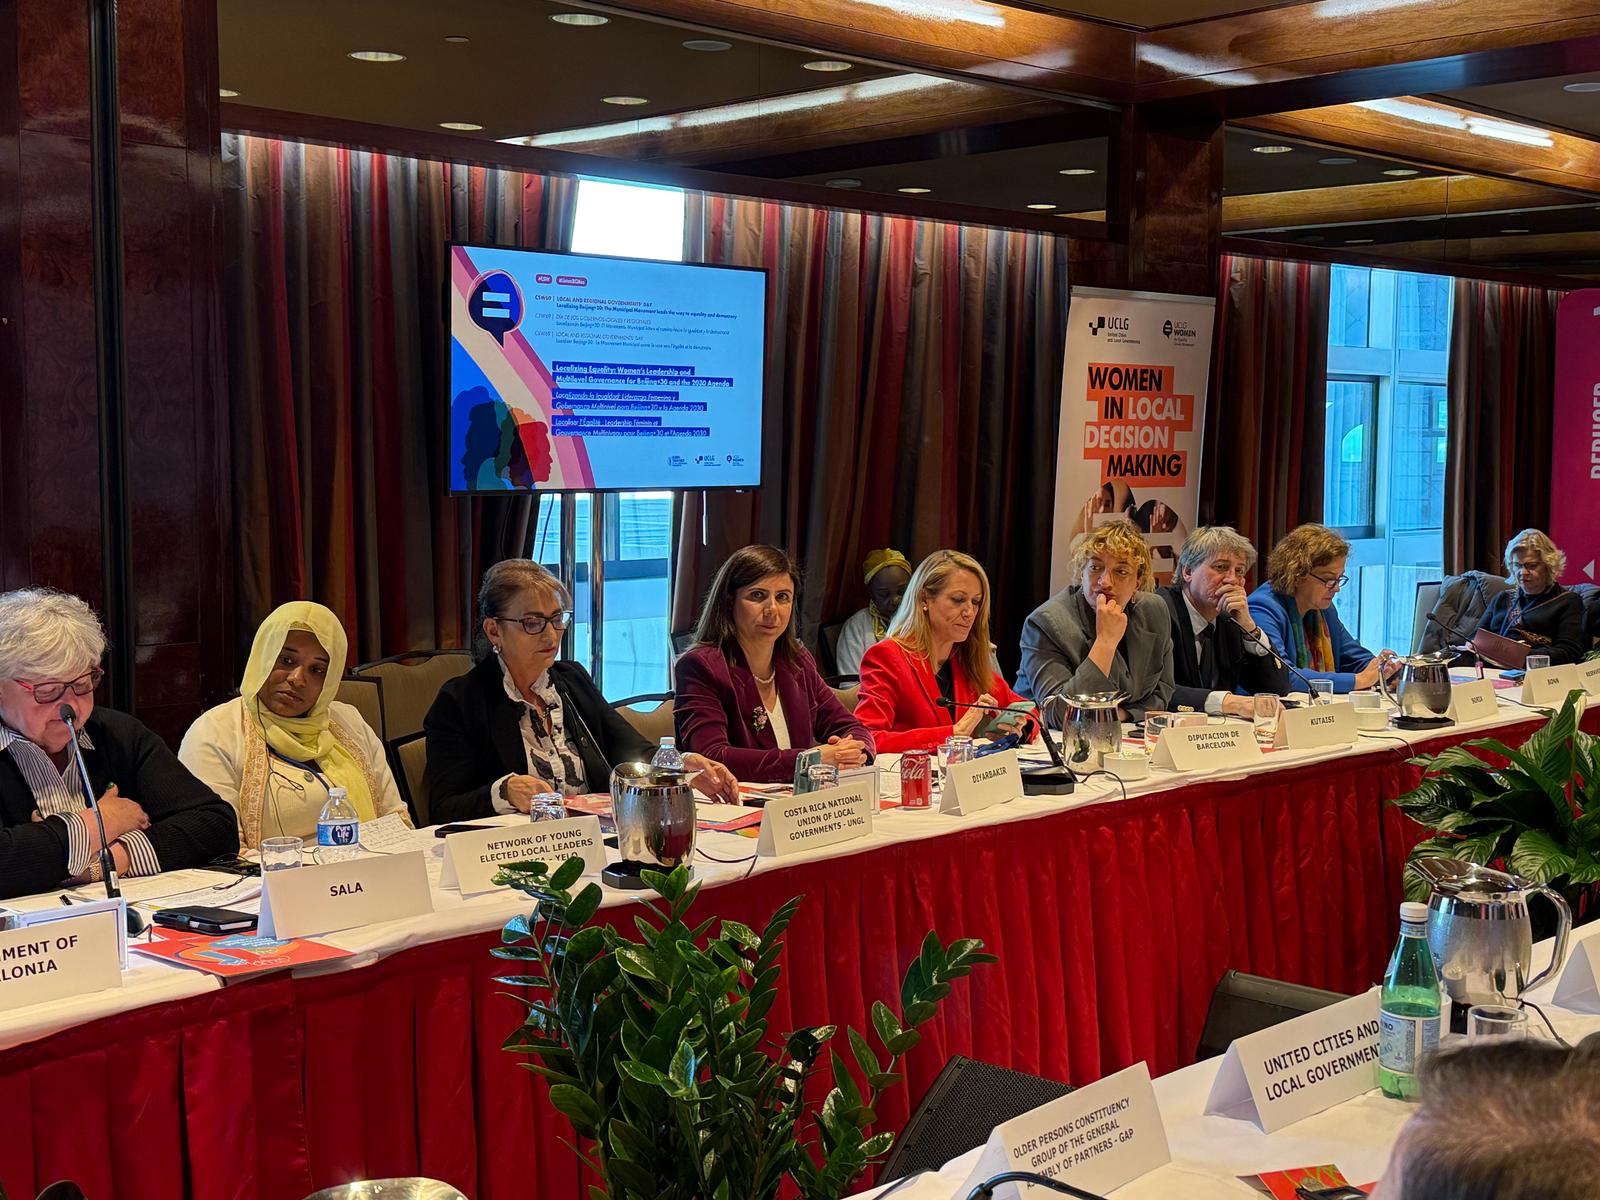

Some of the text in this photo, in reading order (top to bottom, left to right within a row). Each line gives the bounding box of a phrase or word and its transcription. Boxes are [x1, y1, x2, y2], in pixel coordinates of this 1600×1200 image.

[1108, 316, 1129, 330] UCLG
[1174, 321, 1188, 329] UCLG
[1174, 328, 1196, 337] WOMEN
[556, 364, 588, 373] Localizing
[588, 366, 616, 374] Equality:
[1088, 366, 1162, 392] WOMEN
[1104, 396, 1184, 421] IN LOCAL
[1084, 425, 1169, 449] DECISION
[1106, 454, 1182, 477] MAKING
[1310, 715, 1335, 726] KUTAISI
[1188, 730, 1240, 742] DIPUTACION DE
[1196, 740, 1236, 750] BARCELONA
[972, 766, 1008, 784] DIYARBAKIR
[784, 794, 864, 818] COSTA RICA NATIONAL
[789, 822, 842, 840] GOVERNMENTS
[847, 816, 865, 827] UNGL
[797, 808, 855, 827] UNION OF LOCAL
[337, 830, 350, 838] Life
[488, 829, 582, 851] NETWORK OF YOUNG
[480, 838, 594, 864] ELECTED LOCAL LEADERS
[330, 882, 364, 896] SALA
[0, 935, 78, 961] MENT OF
[0, 960, 58, 981] LONIA
[1264, 1046, 1311, 1075] UNITED
[1312, 1030, 1355, 1056] CITIES
[1357, 1020, 1380, 1041] AND
[1265, 1073, 1306, 1102] LOCAL
[1306, 1043, 1380, 1085] GOVERNMEN
[1013, 1097, 1130, 1159] OLDER PERSONS CONSTITUENCY
[1031, 1118, 1120, 1168] GROUP OF THE GENERAL
[1062, 1156, 1073, 1170] OF
[1074, 1138, 1114, 1165] PARTNERS
[1118, 1128, 1134, 1144] GAP
